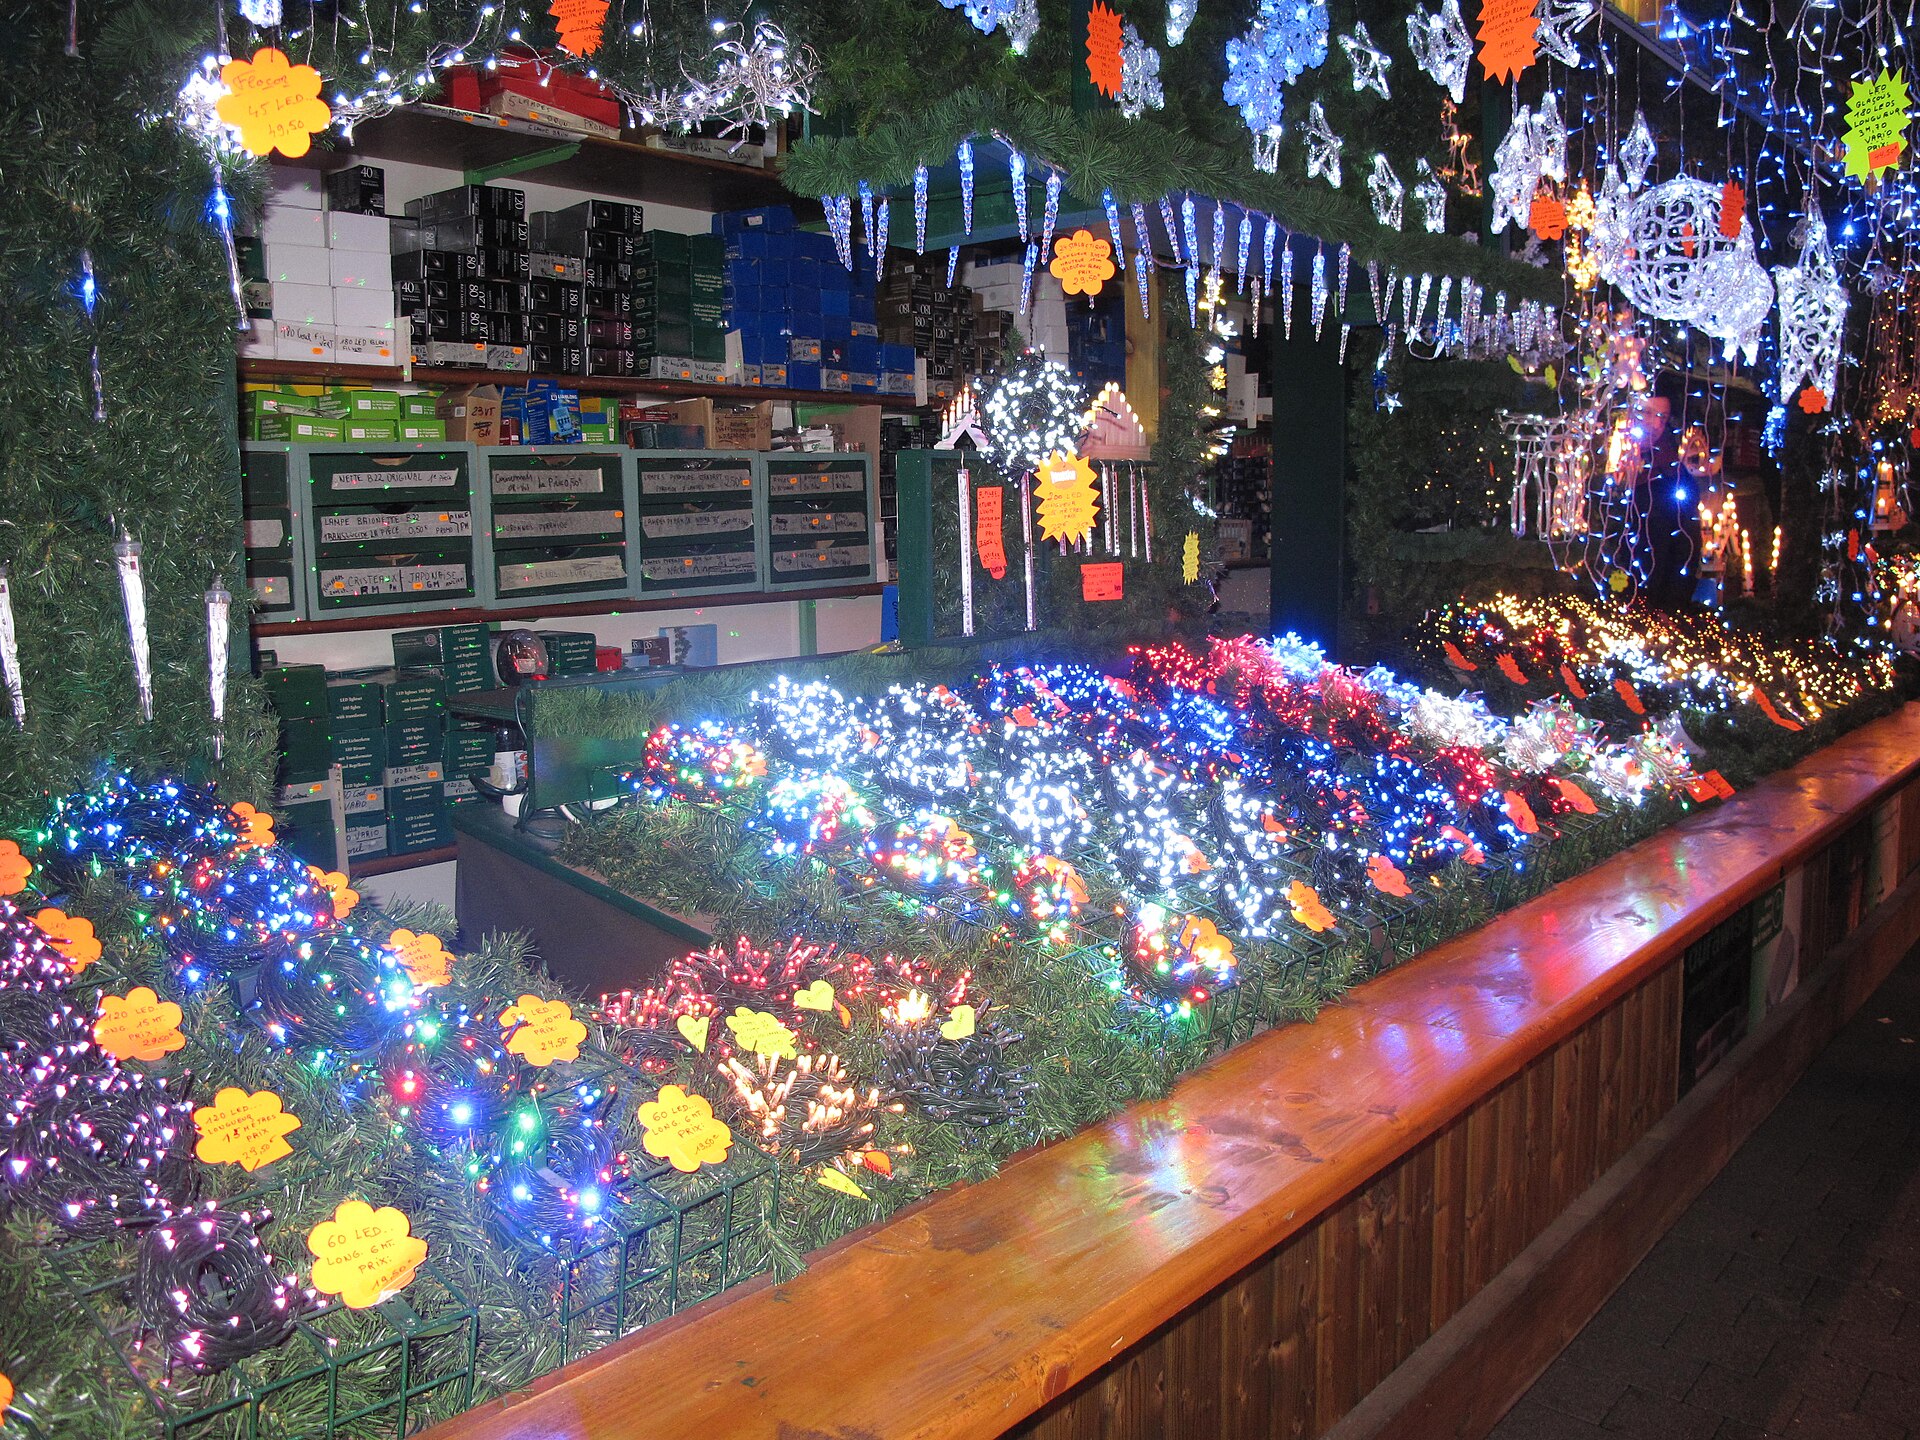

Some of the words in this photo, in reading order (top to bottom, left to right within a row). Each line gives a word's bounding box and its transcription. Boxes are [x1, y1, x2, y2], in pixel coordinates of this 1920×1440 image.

[1868, 84, 1887, 95] LED
[248, 101, 269, 118] 45
[1874, 100, 1896, 112] LEDS
[1854, 107, 1901, 128] LONGUEUR
[360, 166, 373, 179] 40
[514, 191, 524, 210] 120
[632, 207, 642, 226] 240
[518, 222, 528, 241] 120
[624, 236, 634, 255] 240
[466, 255, 477, 270] 80
[520, 253, 530, 272] 120
[586, 268, 596, 288] 240
[401, 282, 415, 293] 40
[468, 283, 479, 298] 80
[569, 288, 579, 306] 180
[621, 293, 631, 312] 240
[470, 312, 480, 326] 80
[568, 319, 578, 337] 180
[480, 322, 489, 340] 120
[623, 322, 632, 340] 240
[570, 348, 580, 366] 180
[625, 350, 635, 369] 240
[324, 518, 350, 527] LAMPE
[205, 1112, 226, 1125] 120
[208, 1113, 253, 1135] LONGUEUR
[652, 1111, 668, 1122] 60
[684, 1115, 691, 1123] 6
[327, 1234, 347, 1248] 60
[370, 1245, 379, 1254] 6
